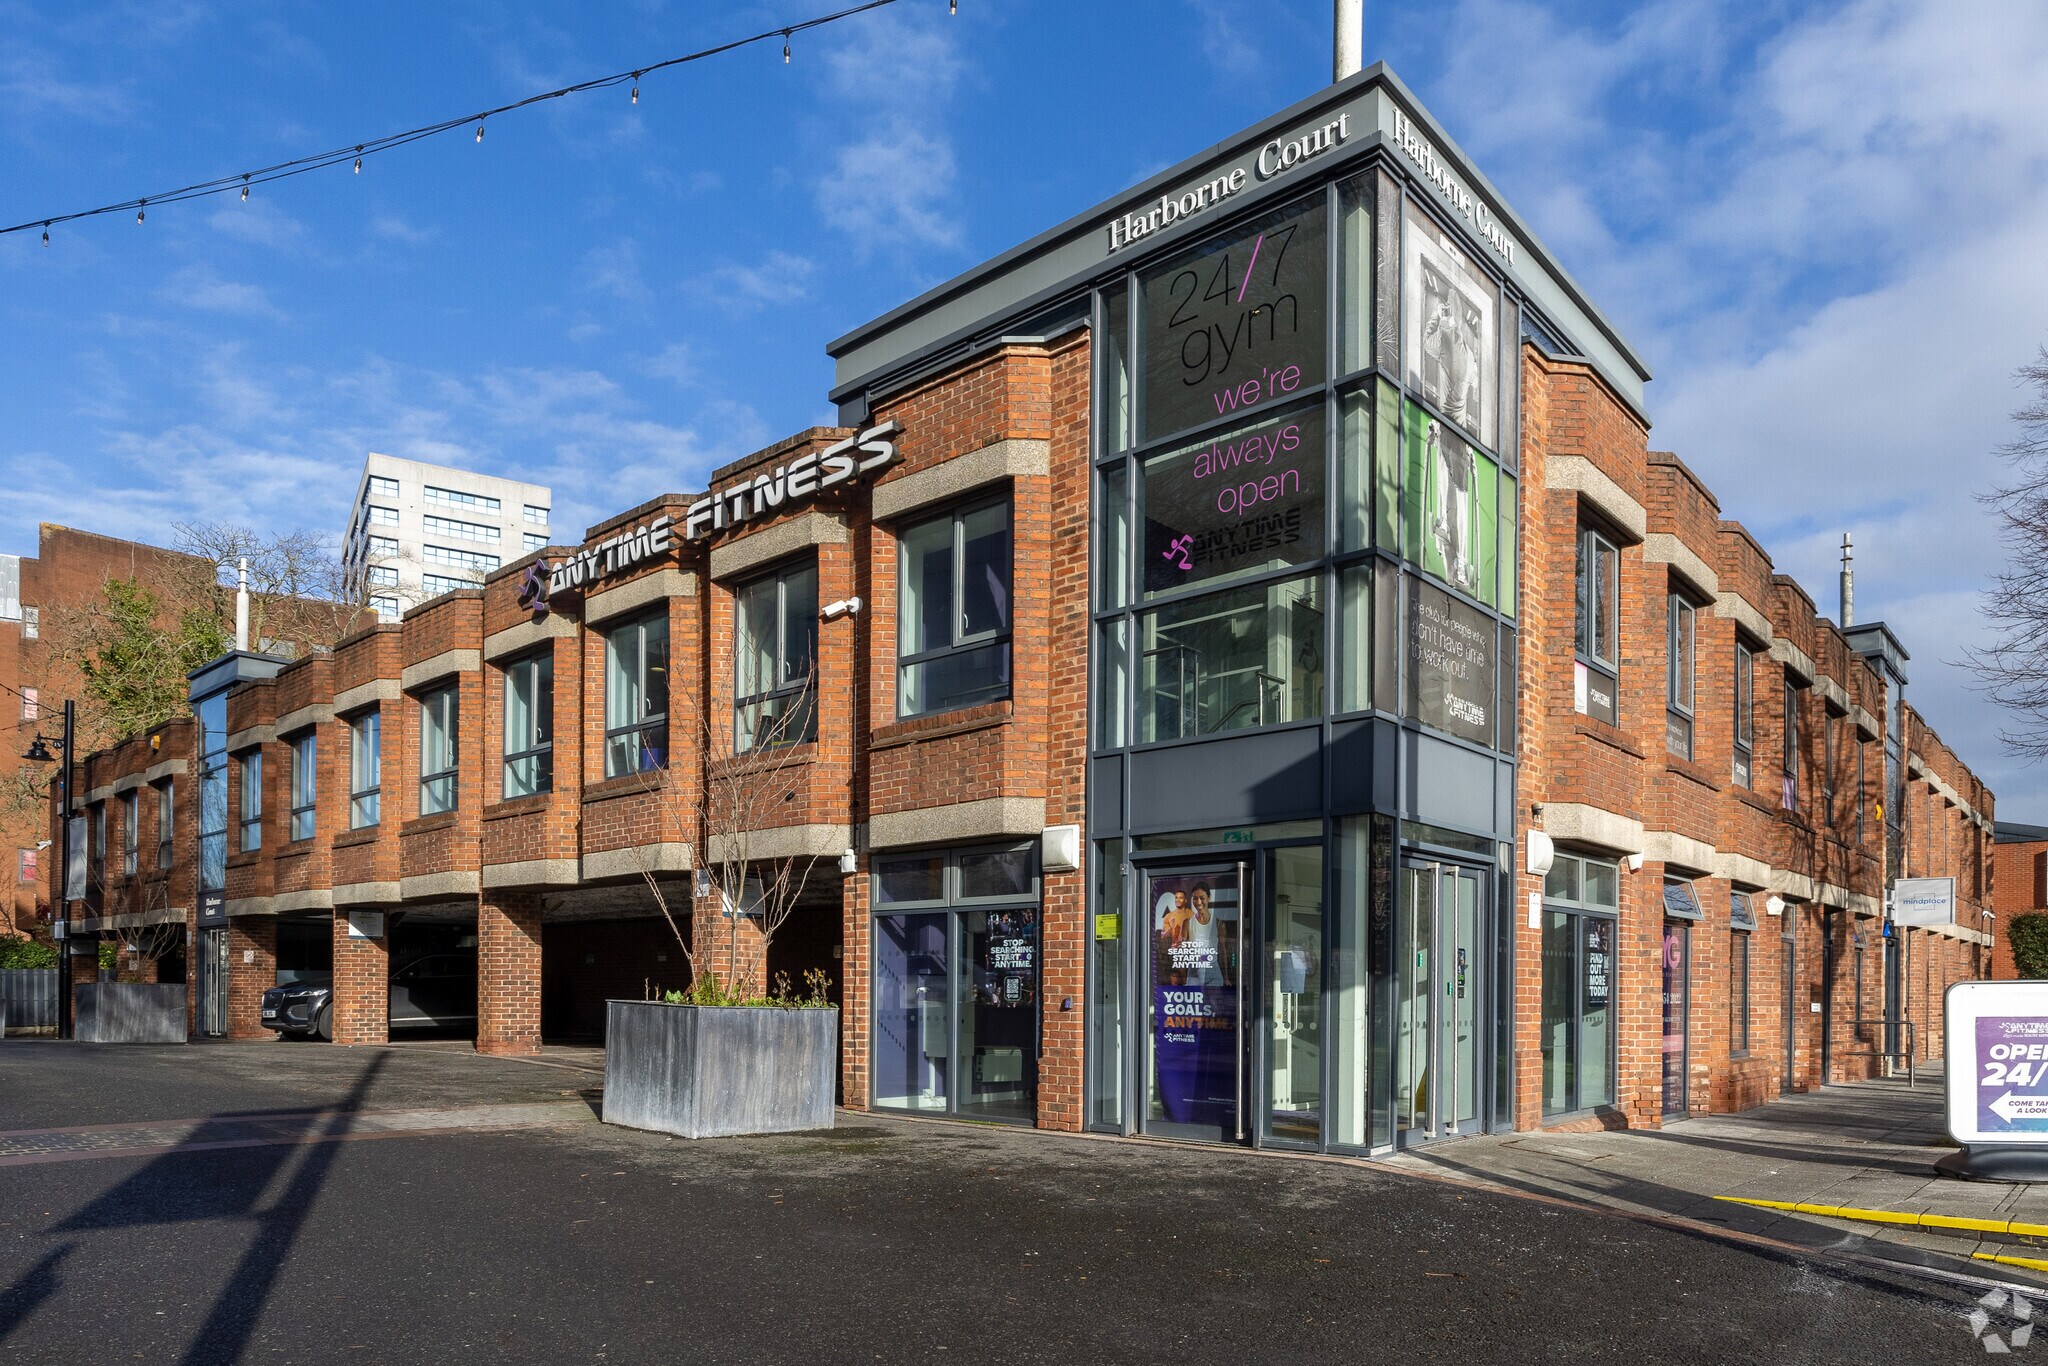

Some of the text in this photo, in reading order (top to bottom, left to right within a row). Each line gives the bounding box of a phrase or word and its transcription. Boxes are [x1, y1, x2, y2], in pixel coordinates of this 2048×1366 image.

[1109, 112, 1351, 251] Harborne Court
[1393, 107, 1515, 267] Harborne Court
[1168, 224, 1298, 329] 24/7
[1181, 294, 1298, 386] gym
[1214, 365, 1300, 414] we're
[1193, 425, 1300, 479] always
[550, 420, 901, 595] ANYTIME FITNESS
[1217, 469, 1300, 516] open
[1193, 527, 1300, 567] FITNESS
[1194, 507, 1300, 551] ANYTIME
[1411, 616, 1485, 667] don't have time
[1411, 638, 1469, 680] to work out.
[1453, 707, 1485, 726] FITNESS
[1902, 897, 1946, 906] mindplace
[990, 946, 1036, 954] SEARCHING.
[1590, 952, 1603, 964] FIND
[1590, 964, 1602, 974] OUT
[1163, 992, 1204, 1003] YOUR
[1589, 986, 1608, 996] TODAY
[1590, 975, 1606, 986] MORE
[1164, 1004, 1216, 1017] GOALS,
